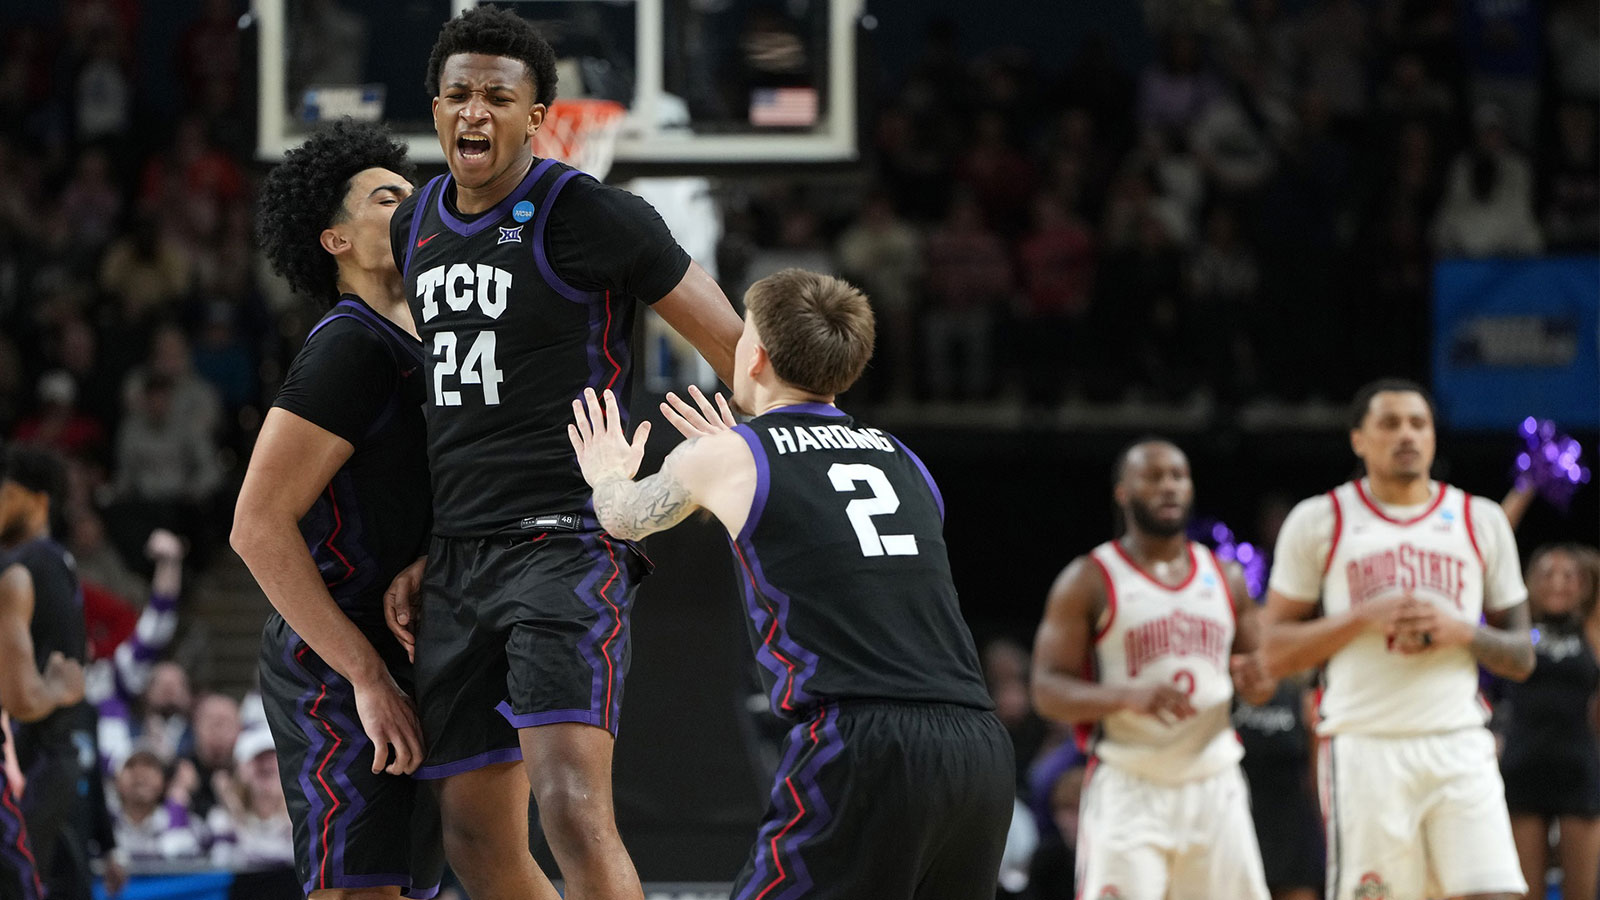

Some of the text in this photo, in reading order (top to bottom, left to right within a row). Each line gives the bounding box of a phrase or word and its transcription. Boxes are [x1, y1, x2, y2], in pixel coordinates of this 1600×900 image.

[416, 263, 513, 323] TCU
[432, 330, 504, 406] 24
[561, 515, 573, 524] 48
[827, 462, 919, 557] 2
